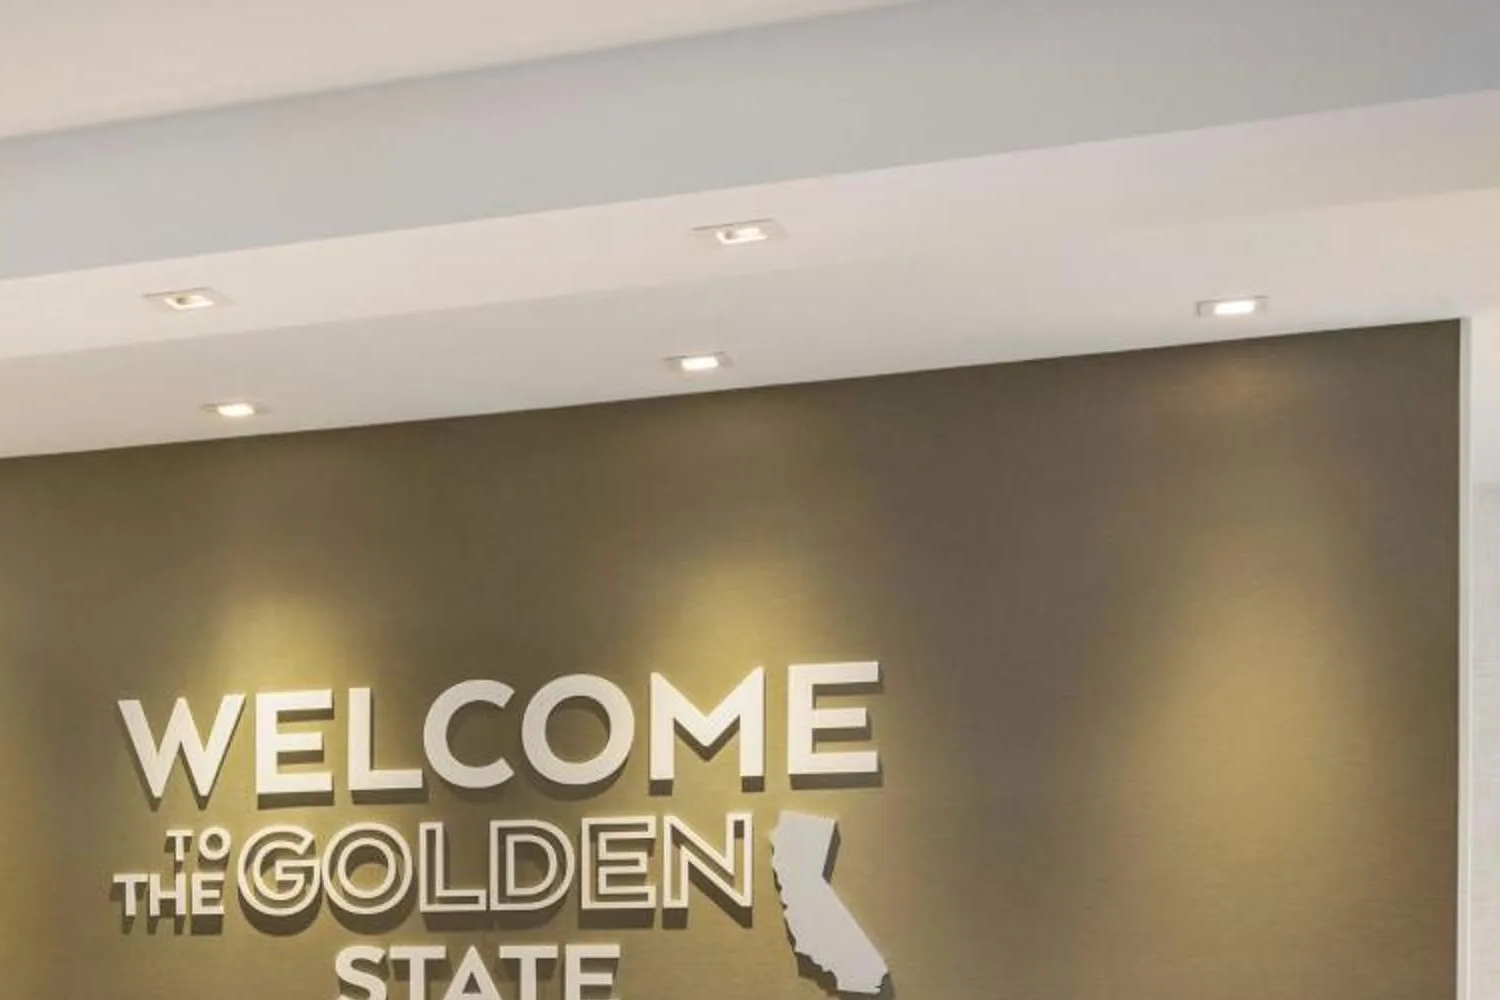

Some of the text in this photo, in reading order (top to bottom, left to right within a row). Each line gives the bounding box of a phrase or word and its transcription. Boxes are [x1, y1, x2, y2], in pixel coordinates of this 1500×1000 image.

[117, 661, 879, 798] WELCOME
[113, 812, 753, 917] THE GOLDEN
[165, 826, 231, 862] TO
